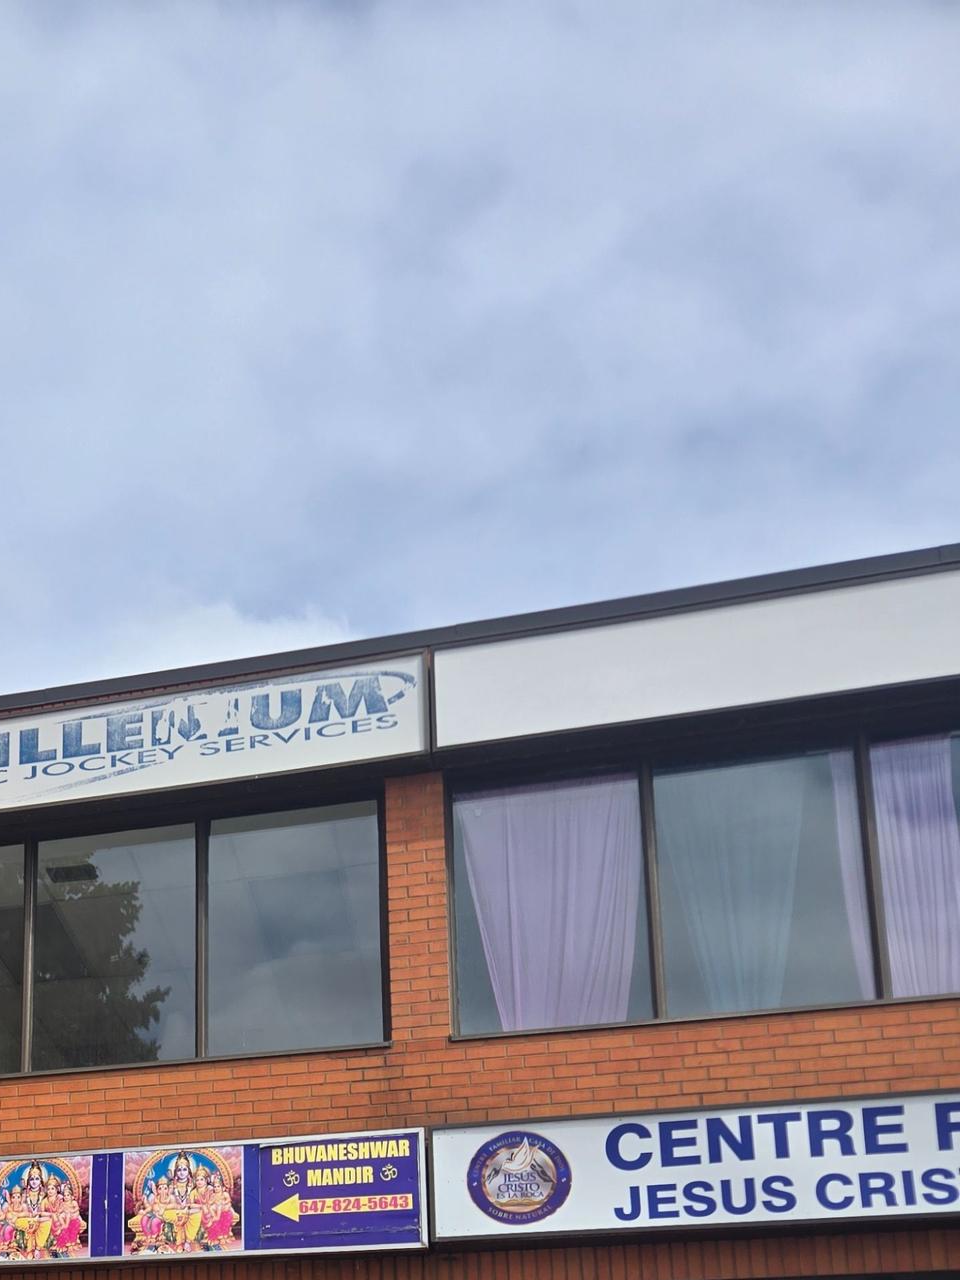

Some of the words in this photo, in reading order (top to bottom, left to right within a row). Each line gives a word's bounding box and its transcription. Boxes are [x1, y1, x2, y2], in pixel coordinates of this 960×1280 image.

[24, 745, 184, 780] JOCKEY
[200, 714, 399, 756] SERVICES
[605, 1105, 909, 1171] CENTRE
[271, 1139, 410, 1165] BHUVANESHWAR
[307, 1166, 374, 1187] MANDIR
[498, 1183, 540, 1193] CRISTO
[299, 1195, 409, 1214] 647-824-5643
[613, 1175, 797, 1221] JESUS
[815, 1168, 960, 1211] CRIS
